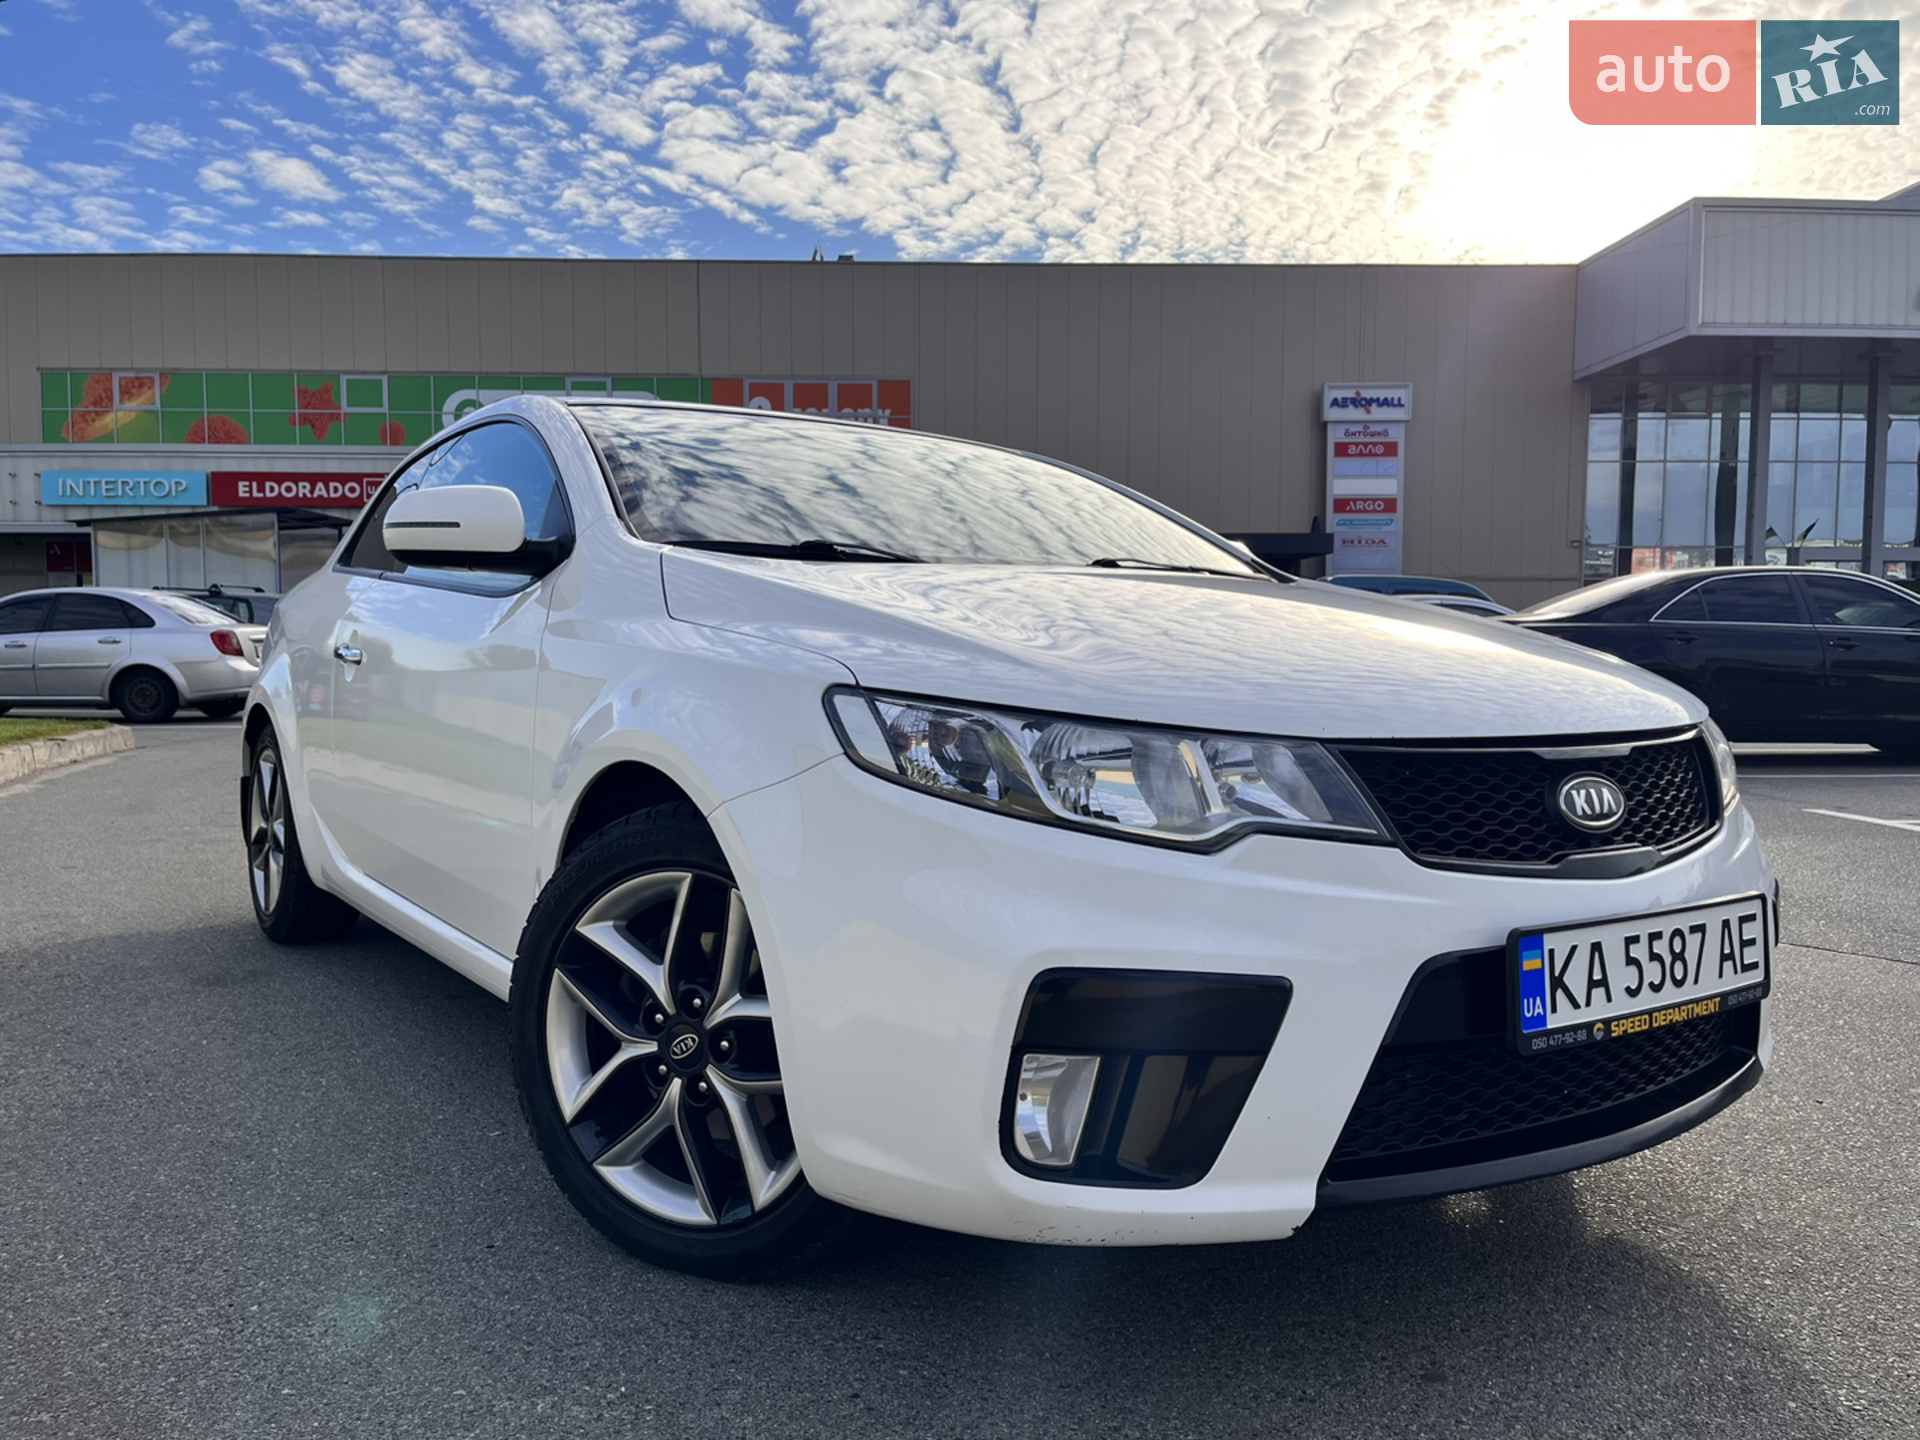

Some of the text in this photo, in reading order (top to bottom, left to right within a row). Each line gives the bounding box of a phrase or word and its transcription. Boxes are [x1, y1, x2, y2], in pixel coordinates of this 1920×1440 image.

[1330, 396, 1404, 409] AEROMALL
[58, 478, 187, 497] INTERTOP
[238, 481, 360, 498] ELDORADO
[1346, 501, 1385, 510] ARGO
[1570, 788, 1617, 816] KIA
[1548, 912, 1760, 1014] KA 5587 AE
[1523, 996, 1544, 1018] UA
[1610, 997, 1721, 1038] SPEED DEPARTMENT
[673, 1037, 694, 1055] KIA
[1549, 1029, 1588, 1047] 477-92-88
